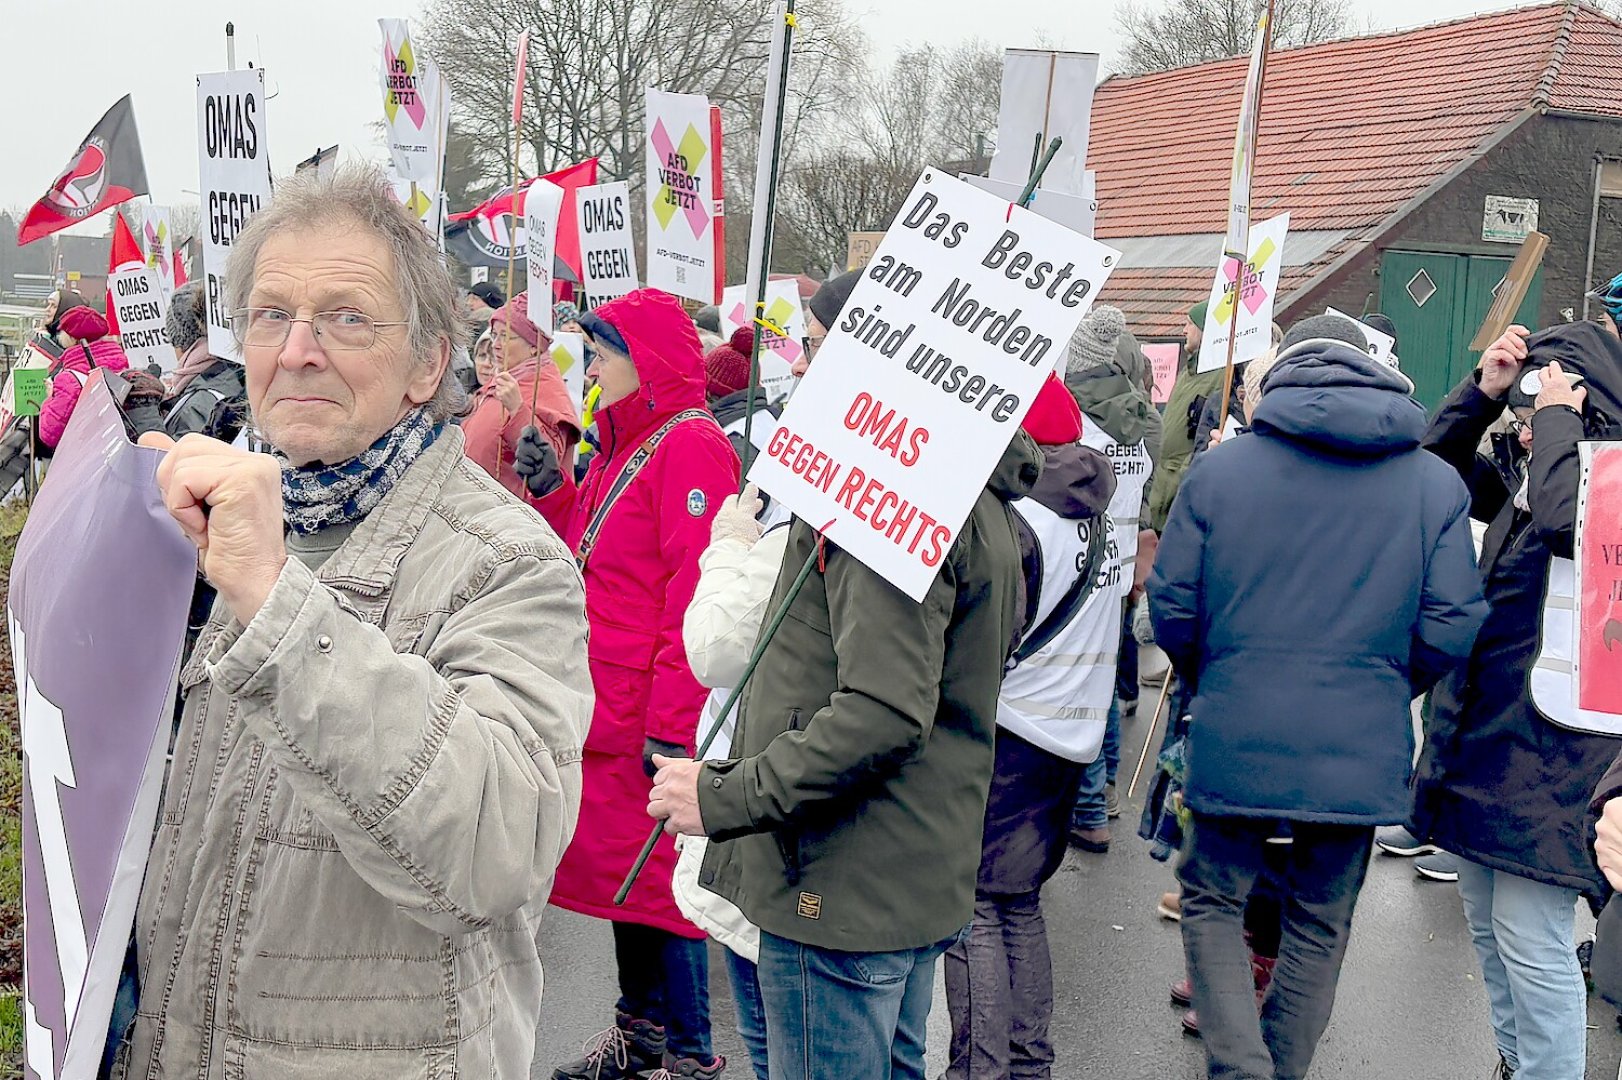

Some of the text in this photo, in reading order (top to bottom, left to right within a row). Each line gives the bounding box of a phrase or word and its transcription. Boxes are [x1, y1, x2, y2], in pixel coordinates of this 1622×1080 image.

[205, 92, 257, 159] OMAS
[667, 152, 688, 172] AFD
[658, 168, 701, 192] VERBOT
[583, 196, 624, 233] OMAS
[664, 188, 697, 211] JETZT
[587, 248, 631, 280] GEGEN
[902, 191, 1091, 308] Das Beste
[117, 276, 149, 297] OMAS
[1223, 270, 1265, 294] VEBOT
[1226, 285, 1258, 305] JTZT
[120, 301, 160, 323] GEGEN
[868, 254, 1053, 368] am Norden
[840, 304, 1021, 423] sind unsere
[843, 391, 931, 467] OMAS
[768, 426, 951, 568] GEGEN RECHTS
